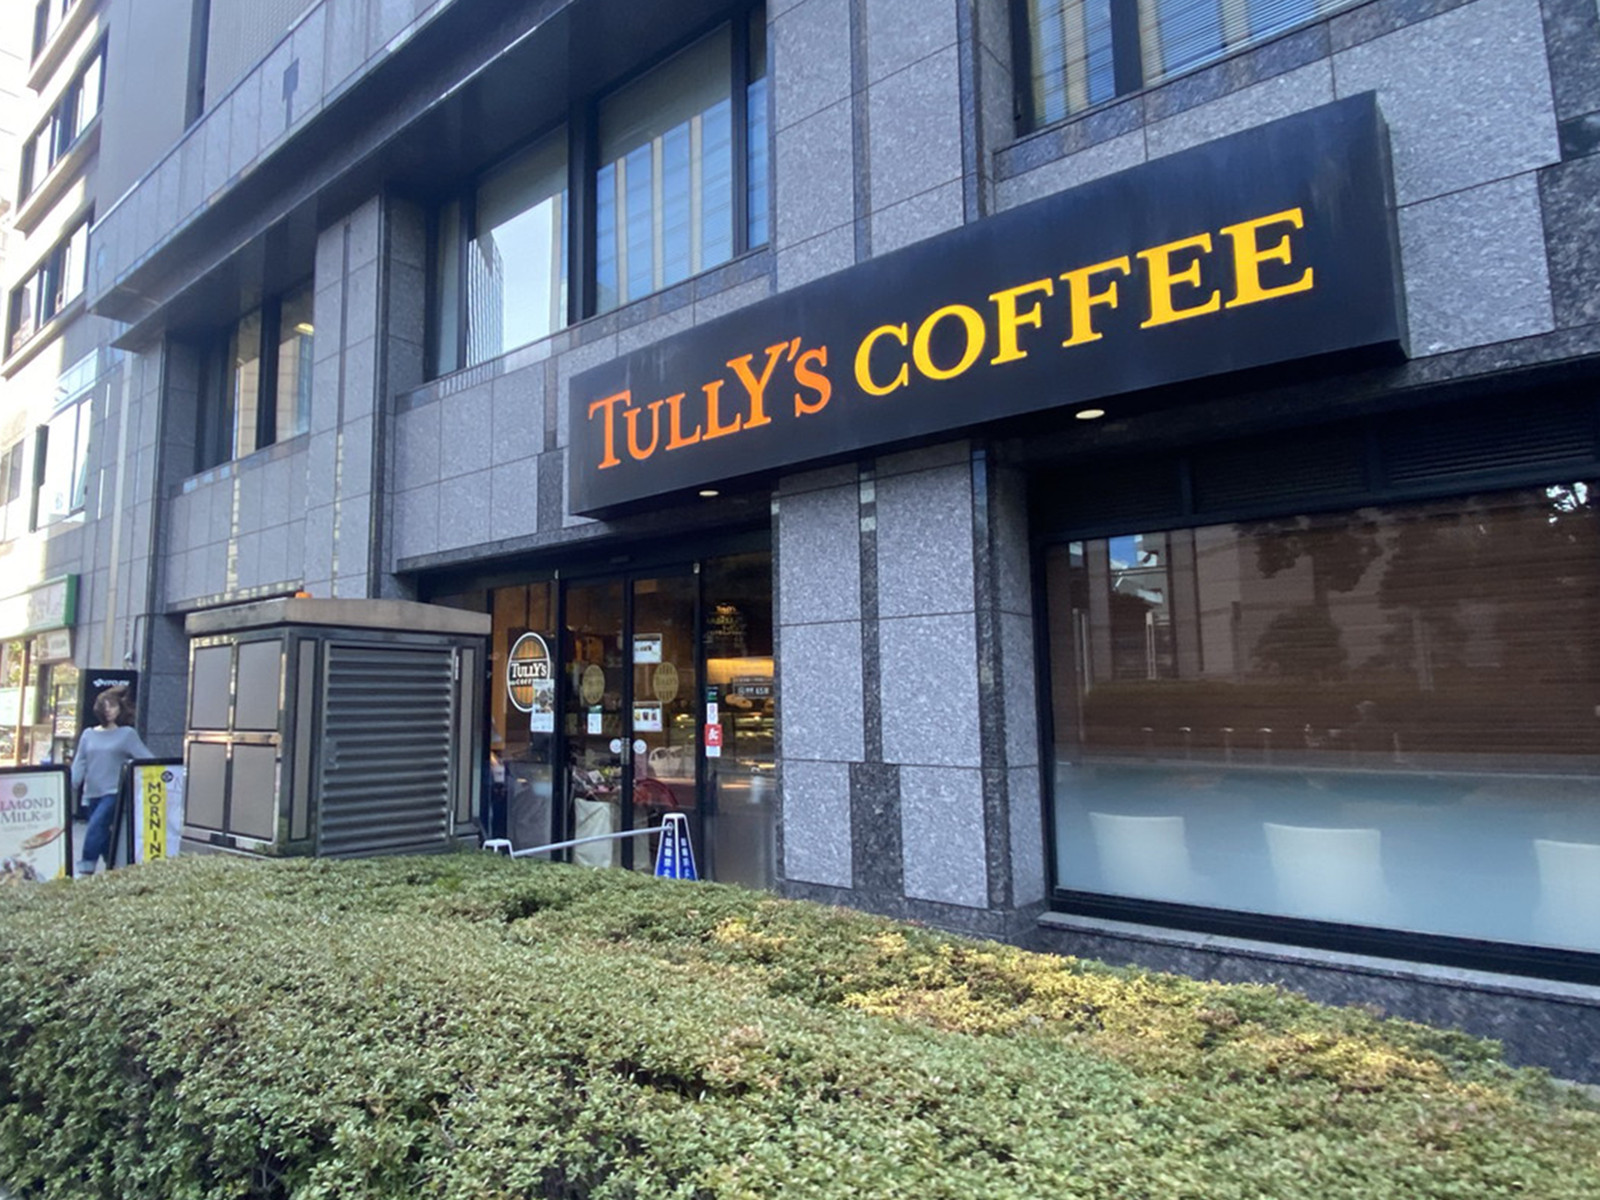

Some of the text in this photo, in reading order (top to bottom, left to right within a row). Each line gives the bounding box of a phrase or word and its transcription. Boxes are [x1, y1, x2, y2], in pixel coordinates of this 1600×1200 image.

[588, 206, 1314, 470] TULLY'S COFFEE
[511, 661, 547, 678] TULLY'S
[0, 797, 54, 811] LMOND
[1, 810, 40, 824] MILK
